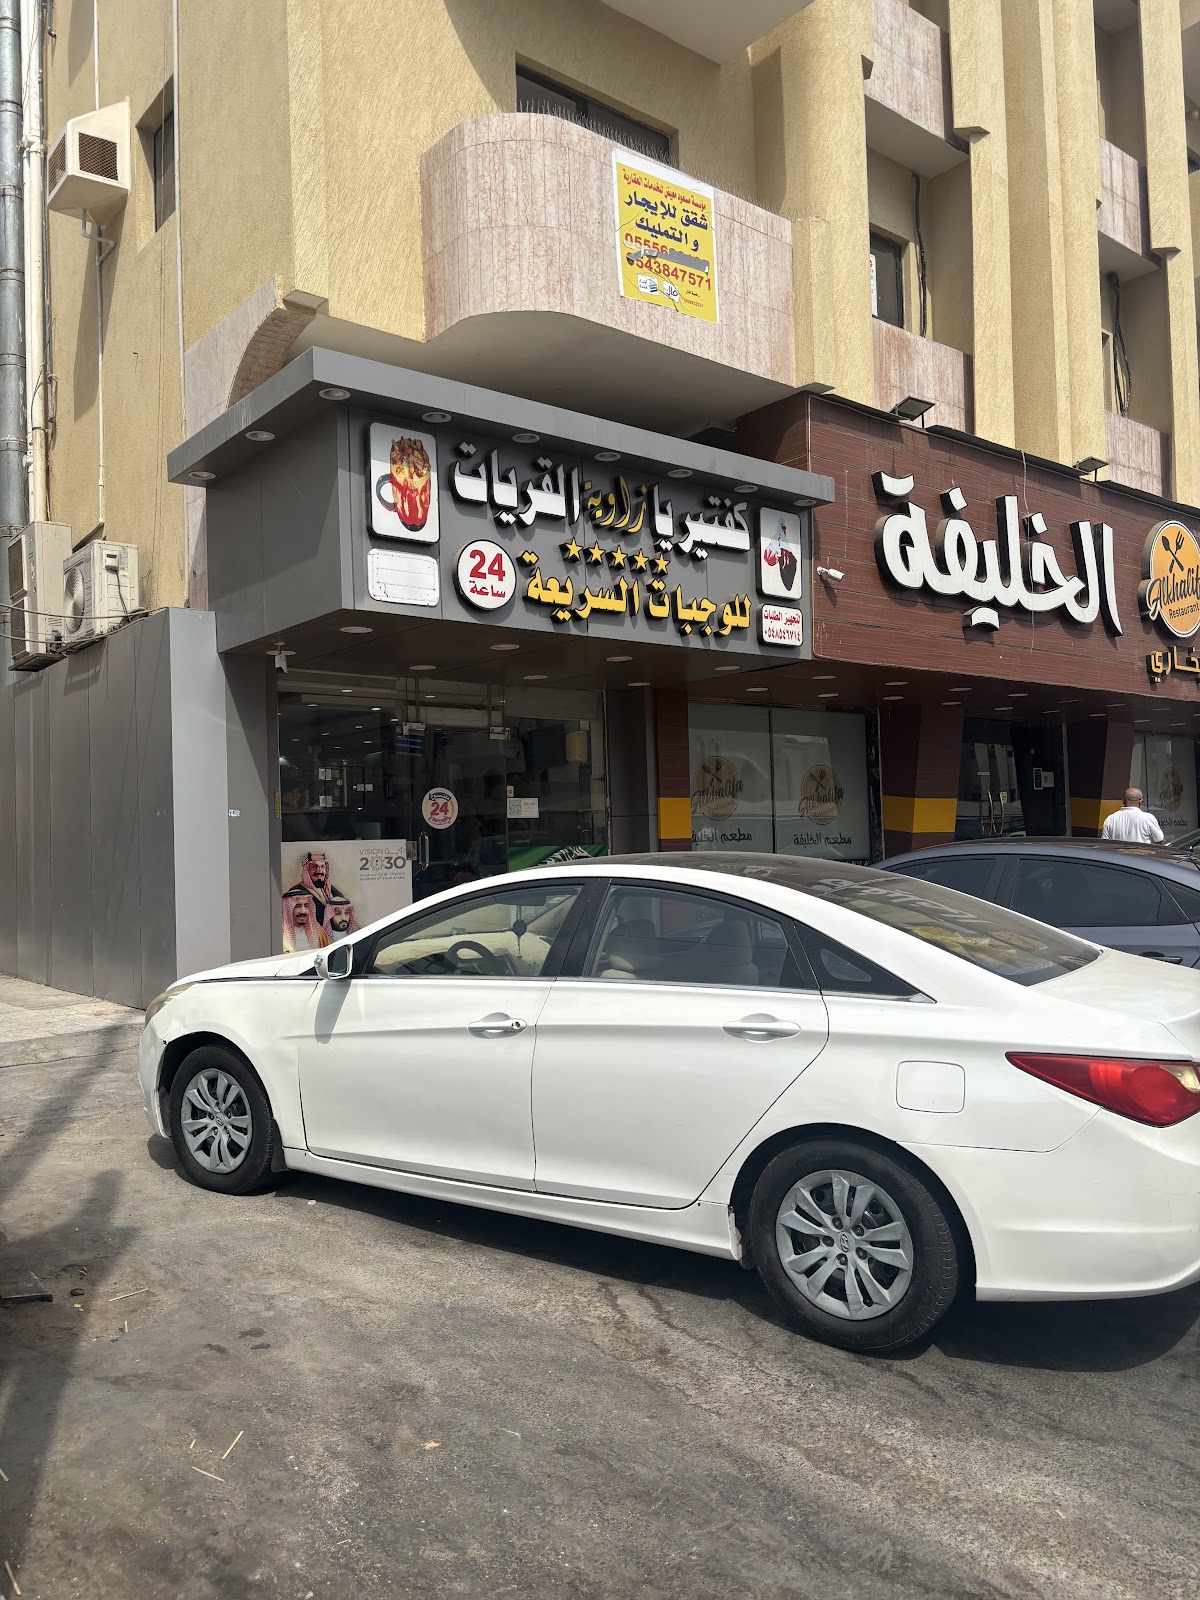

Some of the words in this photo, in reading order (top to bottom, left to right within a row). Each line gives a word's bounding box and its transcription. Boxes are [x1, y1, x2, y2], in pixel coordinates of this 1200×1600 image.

[623, 190, 677, 220] للإيجار
[680, 208, 708, 230] شقق
[452, 441, 580, 527] القريات
[469, 549, 506, 582] 24
[873, 470, 1124, 637] الخليفة
[468, 580, 506, 598] ساعة
[522, 550, 641, 623] السريعة
[1149, 564, 1200, 618] Alkhalif
[647, 578, 752, 637] للوجبات
[1168, 602, 1200, 620] Restaurant
[1150, 645, 1200, 683] خاري
[430, 801, 449, 816] 24
[691, 779, 744, 815] Alkhalifa
[692, 829, 718, 845] الخليف
[720, 828, 752, 844] مطعم
[793, 833, 822, 847] الخليفة
[824, 832, 852, 845] مطعم
